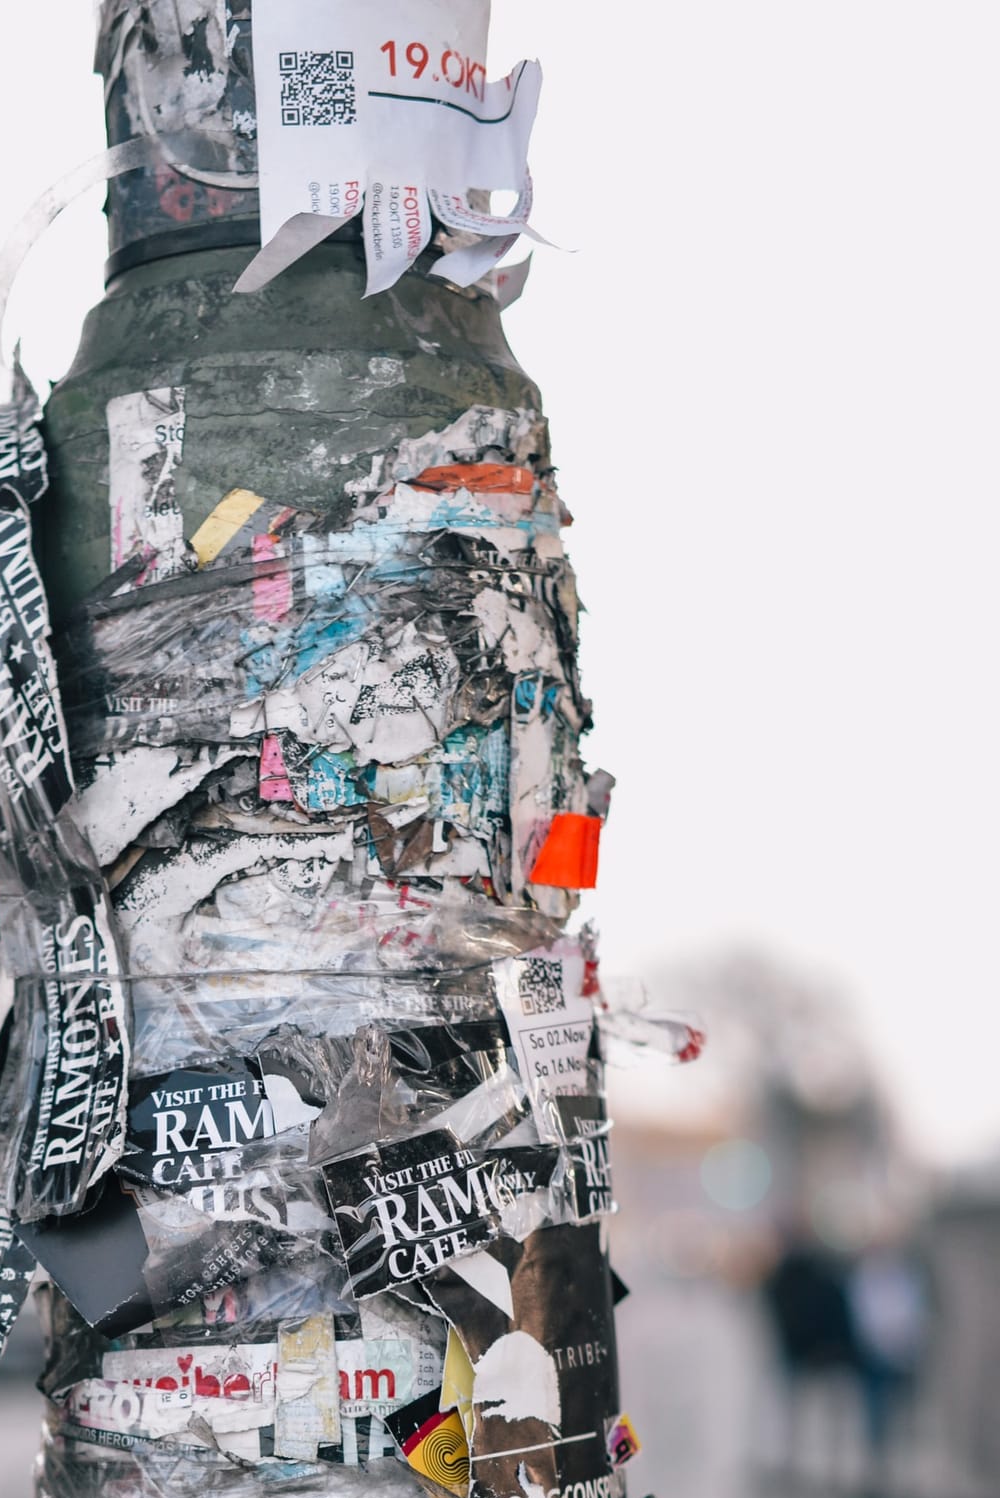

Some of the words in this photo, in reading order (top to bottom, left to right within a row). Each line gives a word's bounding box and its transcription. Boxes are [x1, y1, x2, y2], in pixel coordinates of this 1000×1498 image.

[43, 914, 100, 1171] RAMONES
[151, 1087, 204, 1110] VISIT
[208, 1080, 247, 1101] THE
[363, 1167, 413, 1196] VISIT
[416, 1154, 454, 1181] THE
[387, 1228, 469, 1280] CAFE
